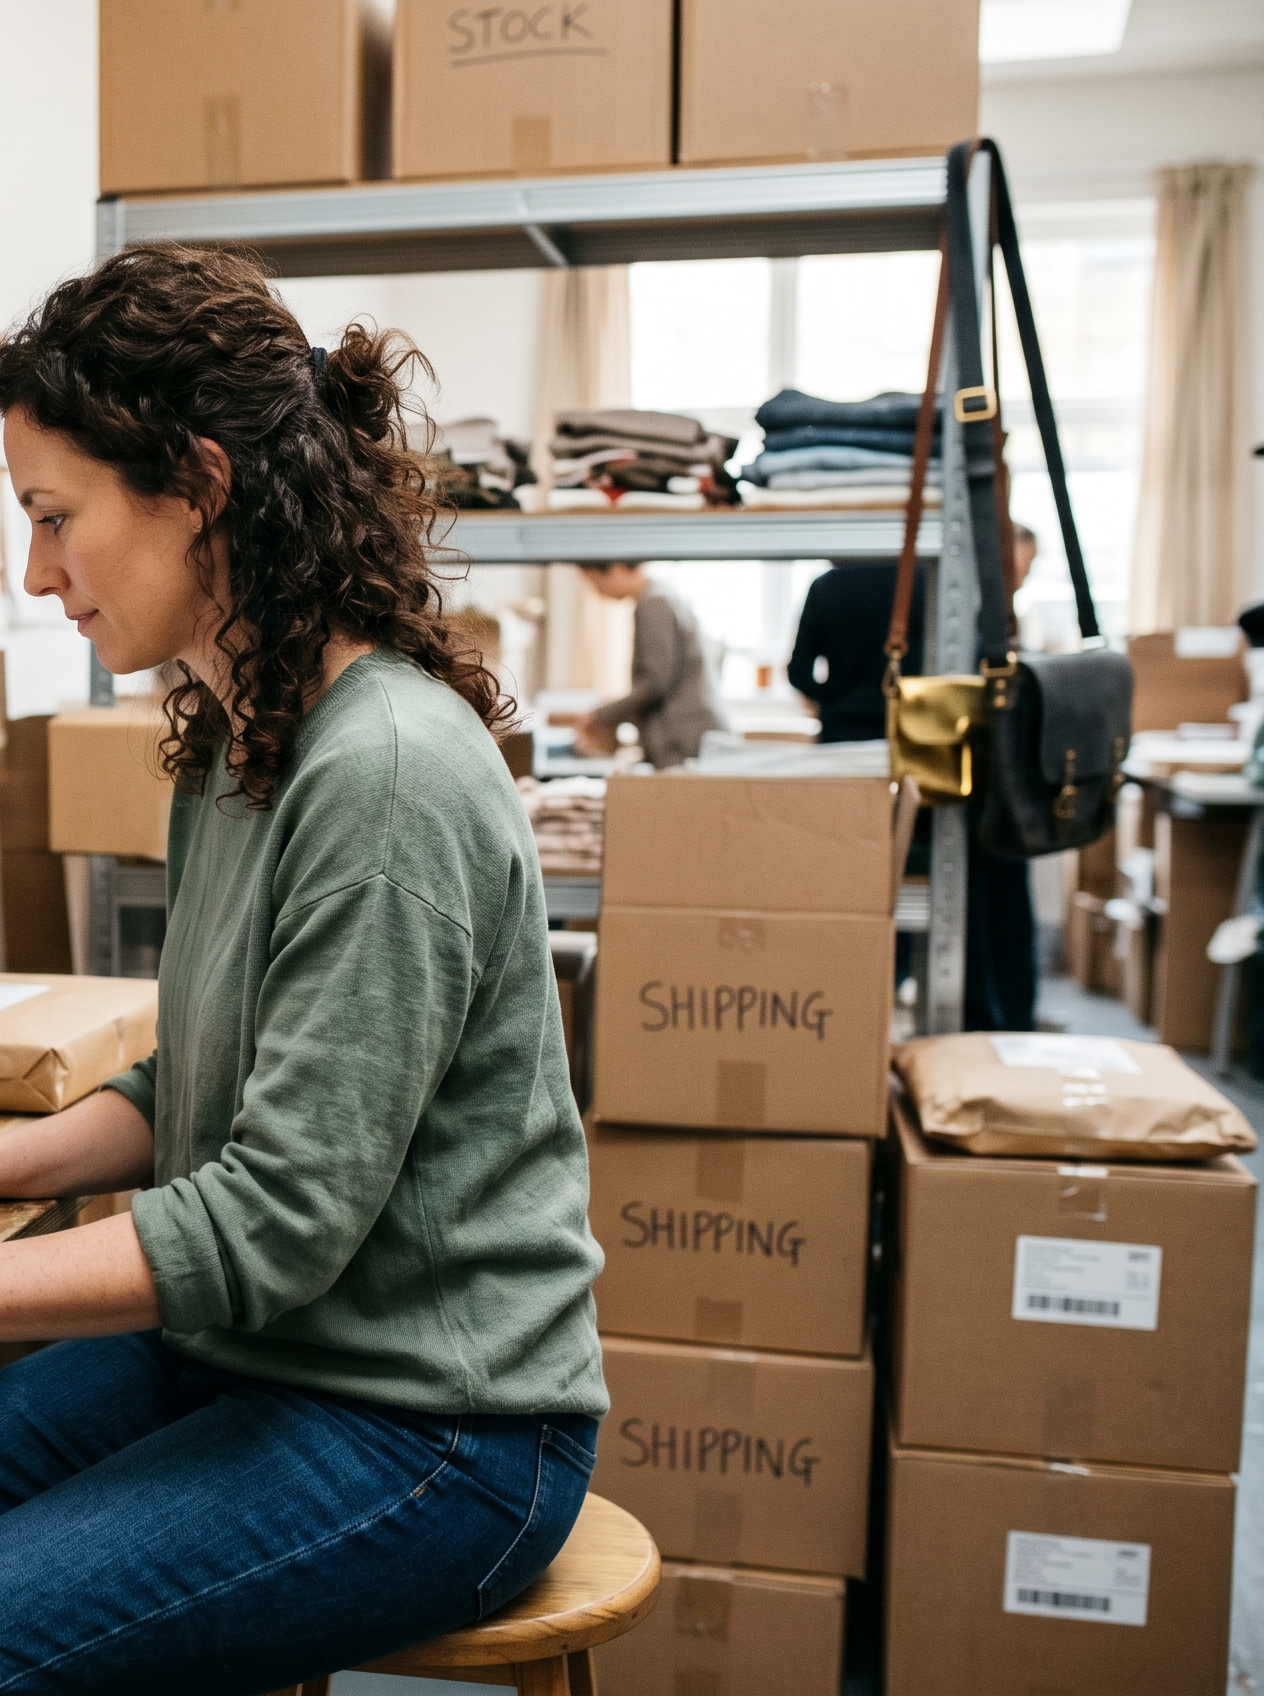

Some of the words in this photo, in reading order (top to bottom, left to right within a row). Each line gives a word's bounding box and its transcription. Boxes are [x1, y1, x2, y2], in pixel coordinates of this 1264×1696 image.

[447, 4, 593, 55] STOCK
[639, 980, 831, 1041] SHIPPING
[620, 1201, 806, 1267] SHIPPING
[619, 1418, 820, 1486] SHIPPING
